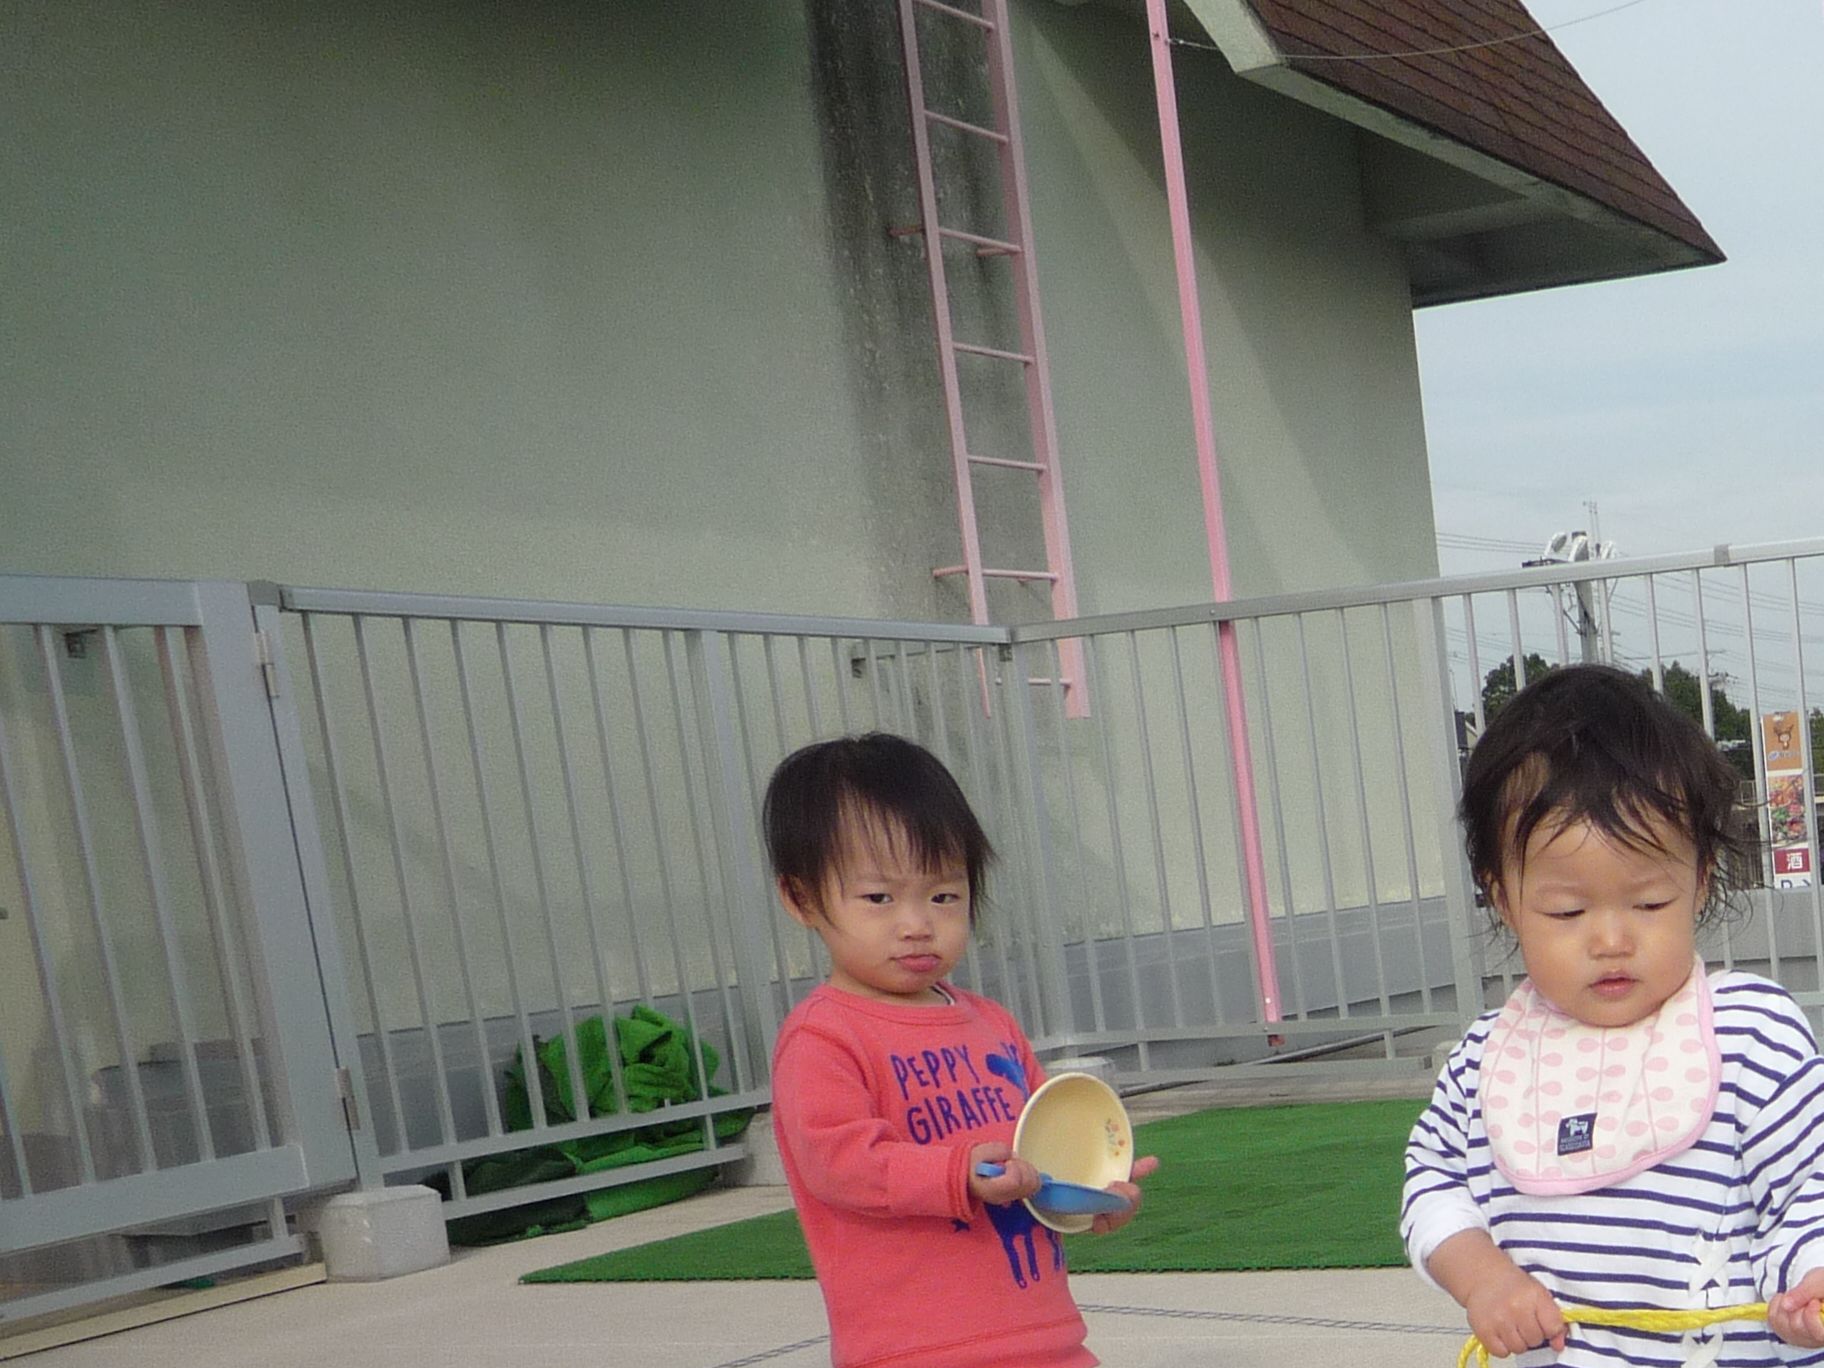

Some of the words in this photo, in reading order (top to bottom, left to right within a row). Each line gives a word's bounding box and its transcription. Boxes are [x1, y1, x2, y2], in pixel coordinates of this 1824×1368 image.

[1786, 852, 1804, 871] 酒
[890, 1044, 981, 1101] PEPPY
[906, 1086, 1017, 1145] GIRAFFE
